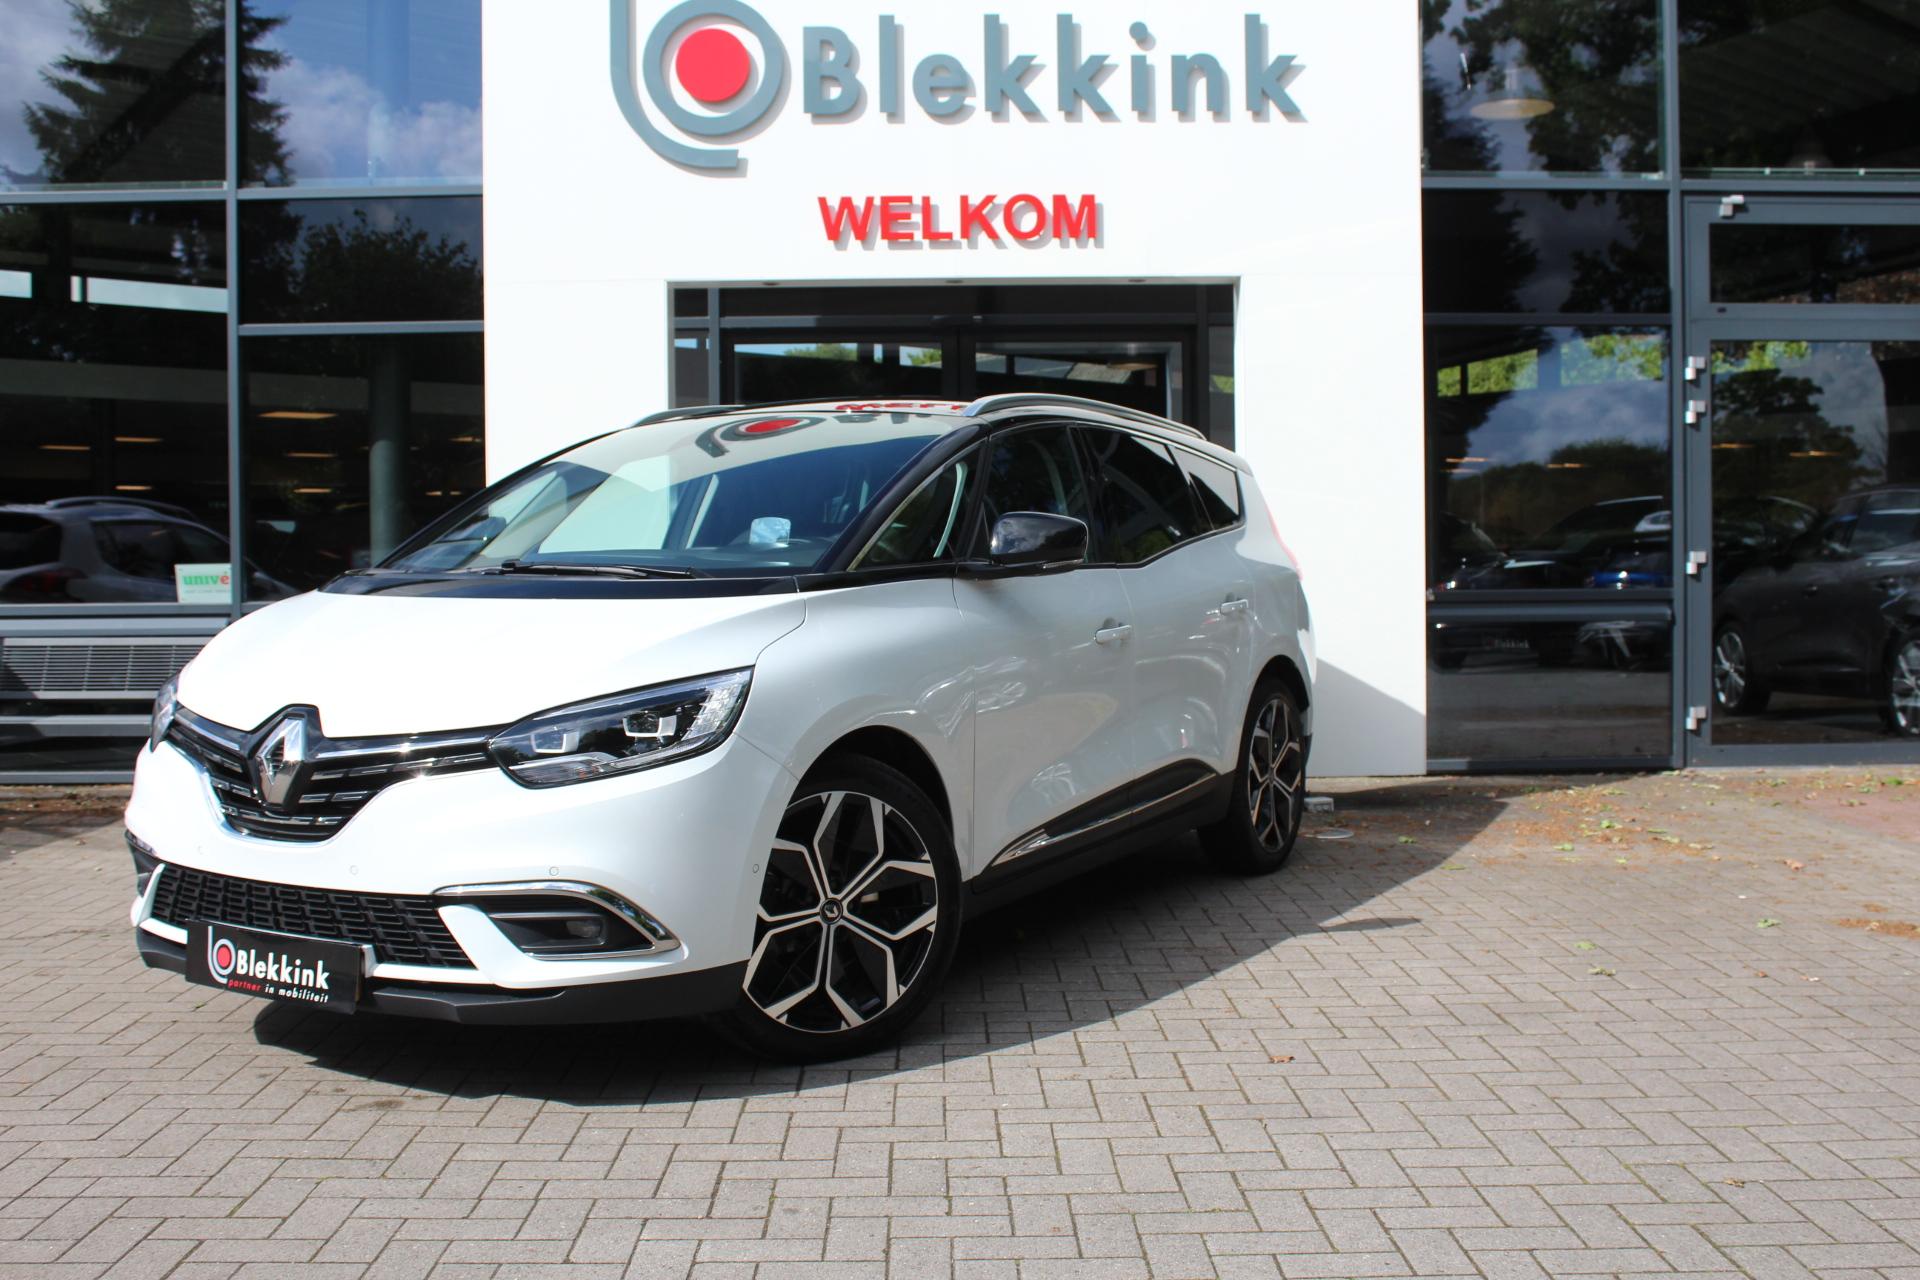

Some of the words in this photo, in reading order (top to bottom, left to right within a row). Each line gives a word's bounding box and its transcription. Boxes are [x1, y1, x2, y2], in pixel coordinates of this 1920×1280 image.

[804, 14, 1300, 116] Blekkink
[818, 194, 1098, 241] WELKOM
[228, 979, 261, 991] partner
[265, 984, 275, 994] in
[278, 986, 329, 1003] mobiliteit
[236, 949, 330, 990] Blekkink
